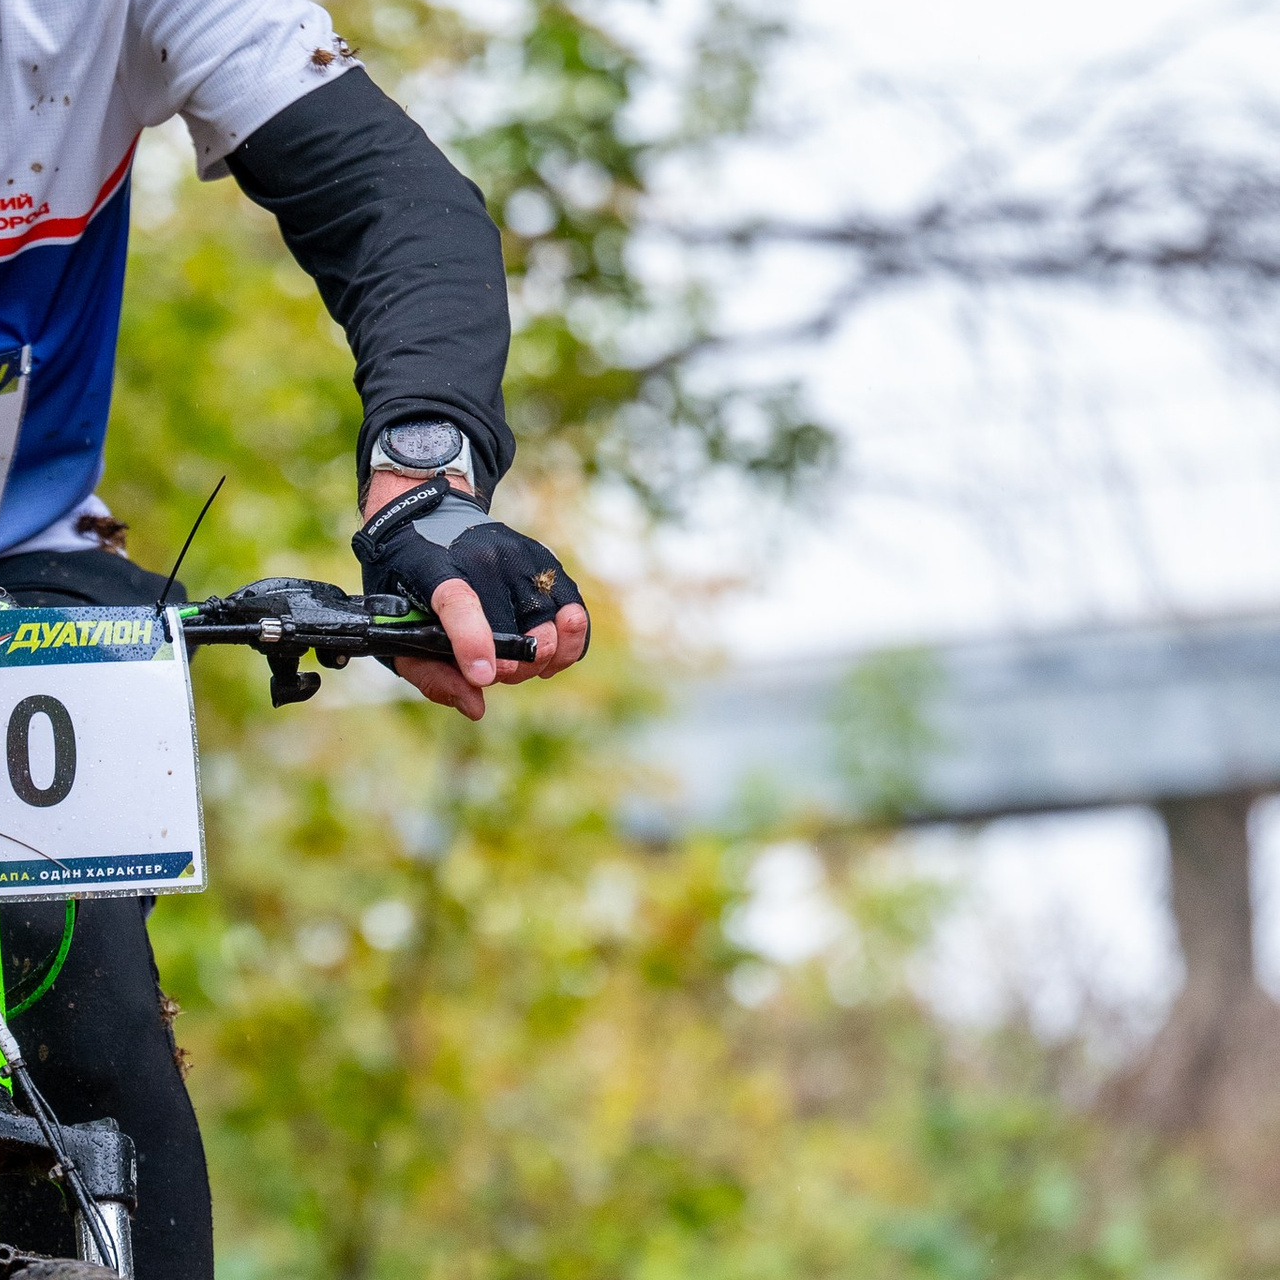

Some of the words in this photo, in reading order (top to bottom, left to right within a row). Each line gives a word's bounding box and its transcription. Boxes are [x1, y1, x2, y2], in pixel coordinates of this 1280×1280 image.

[367, 487, 439, 536] ROCKBROS
[7, 620, 154, 655] ДУАТЛОН
[40, 869, 82, 880] ОДИН
[86, 864, 168, 878] ХАРАКТЕР.
